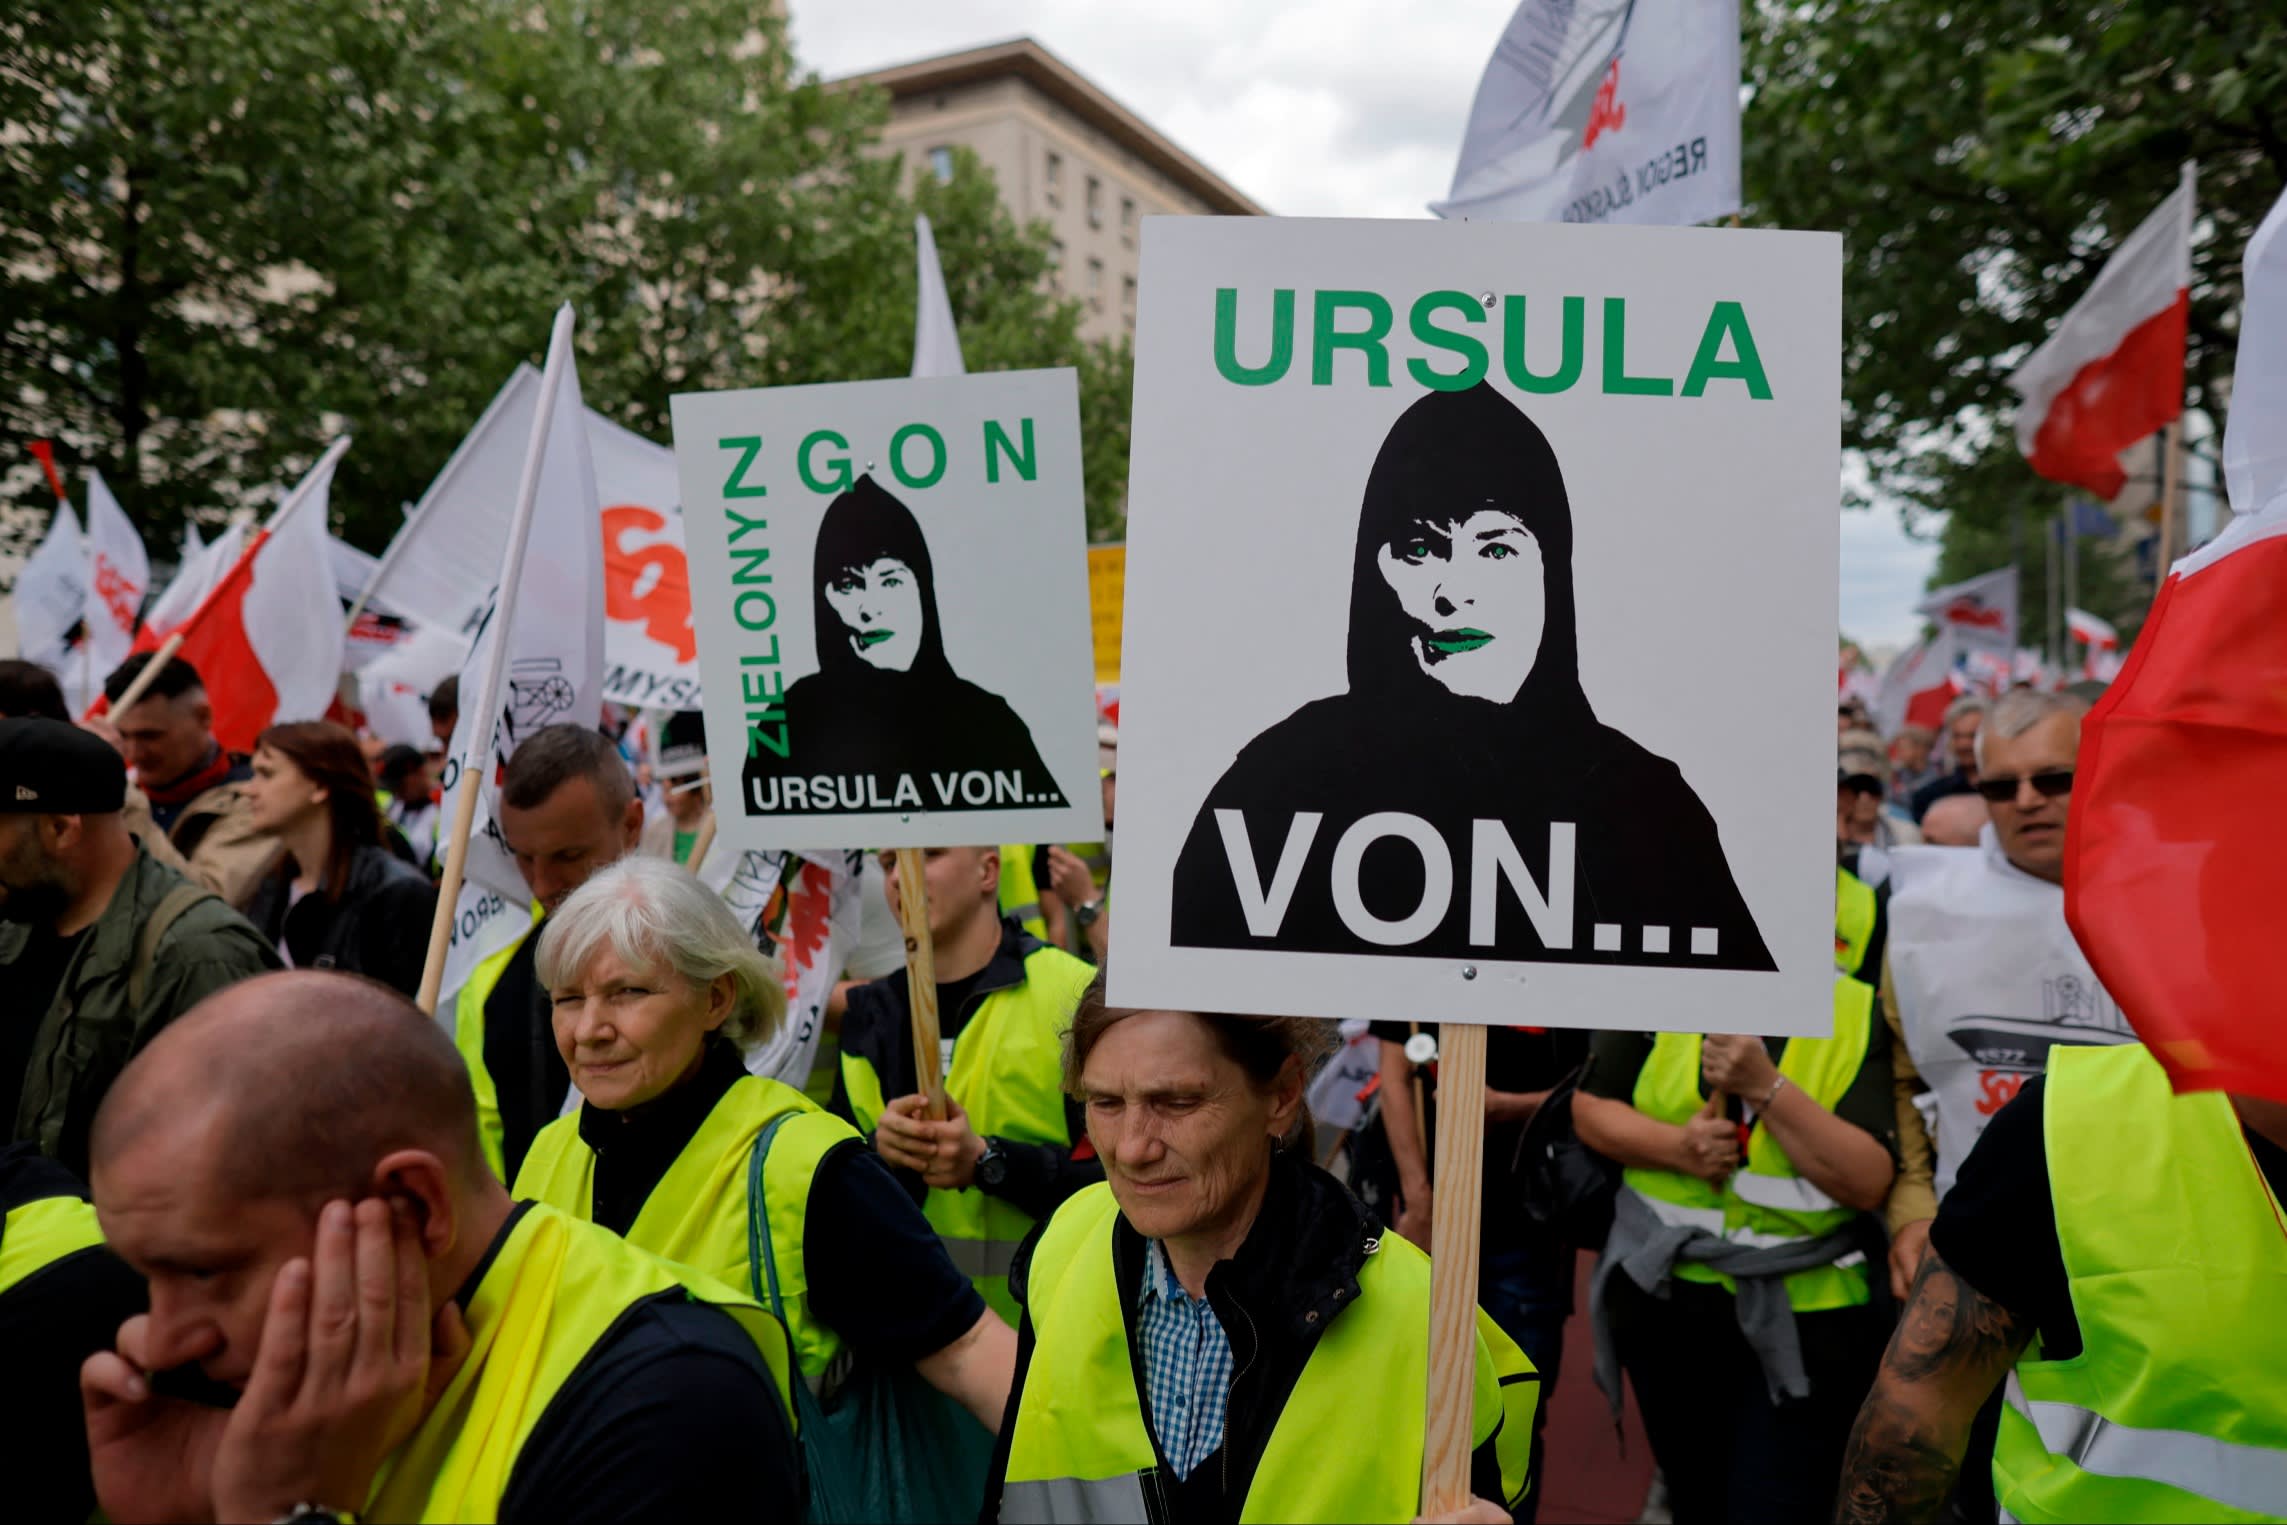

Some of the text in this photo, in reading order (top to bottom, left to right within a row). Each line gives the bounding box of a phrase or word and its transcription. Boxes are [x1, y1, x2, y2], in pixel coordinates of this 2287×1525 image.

[1214, 287, 1774, 400] URSULA
[718, 417, 1037, 499] ZGON
[724, 508, 791, 759] ZIELONY
[752, 769, 1059, 811] URSULA VON...
[1213, 808, 1719, 955] VON...
